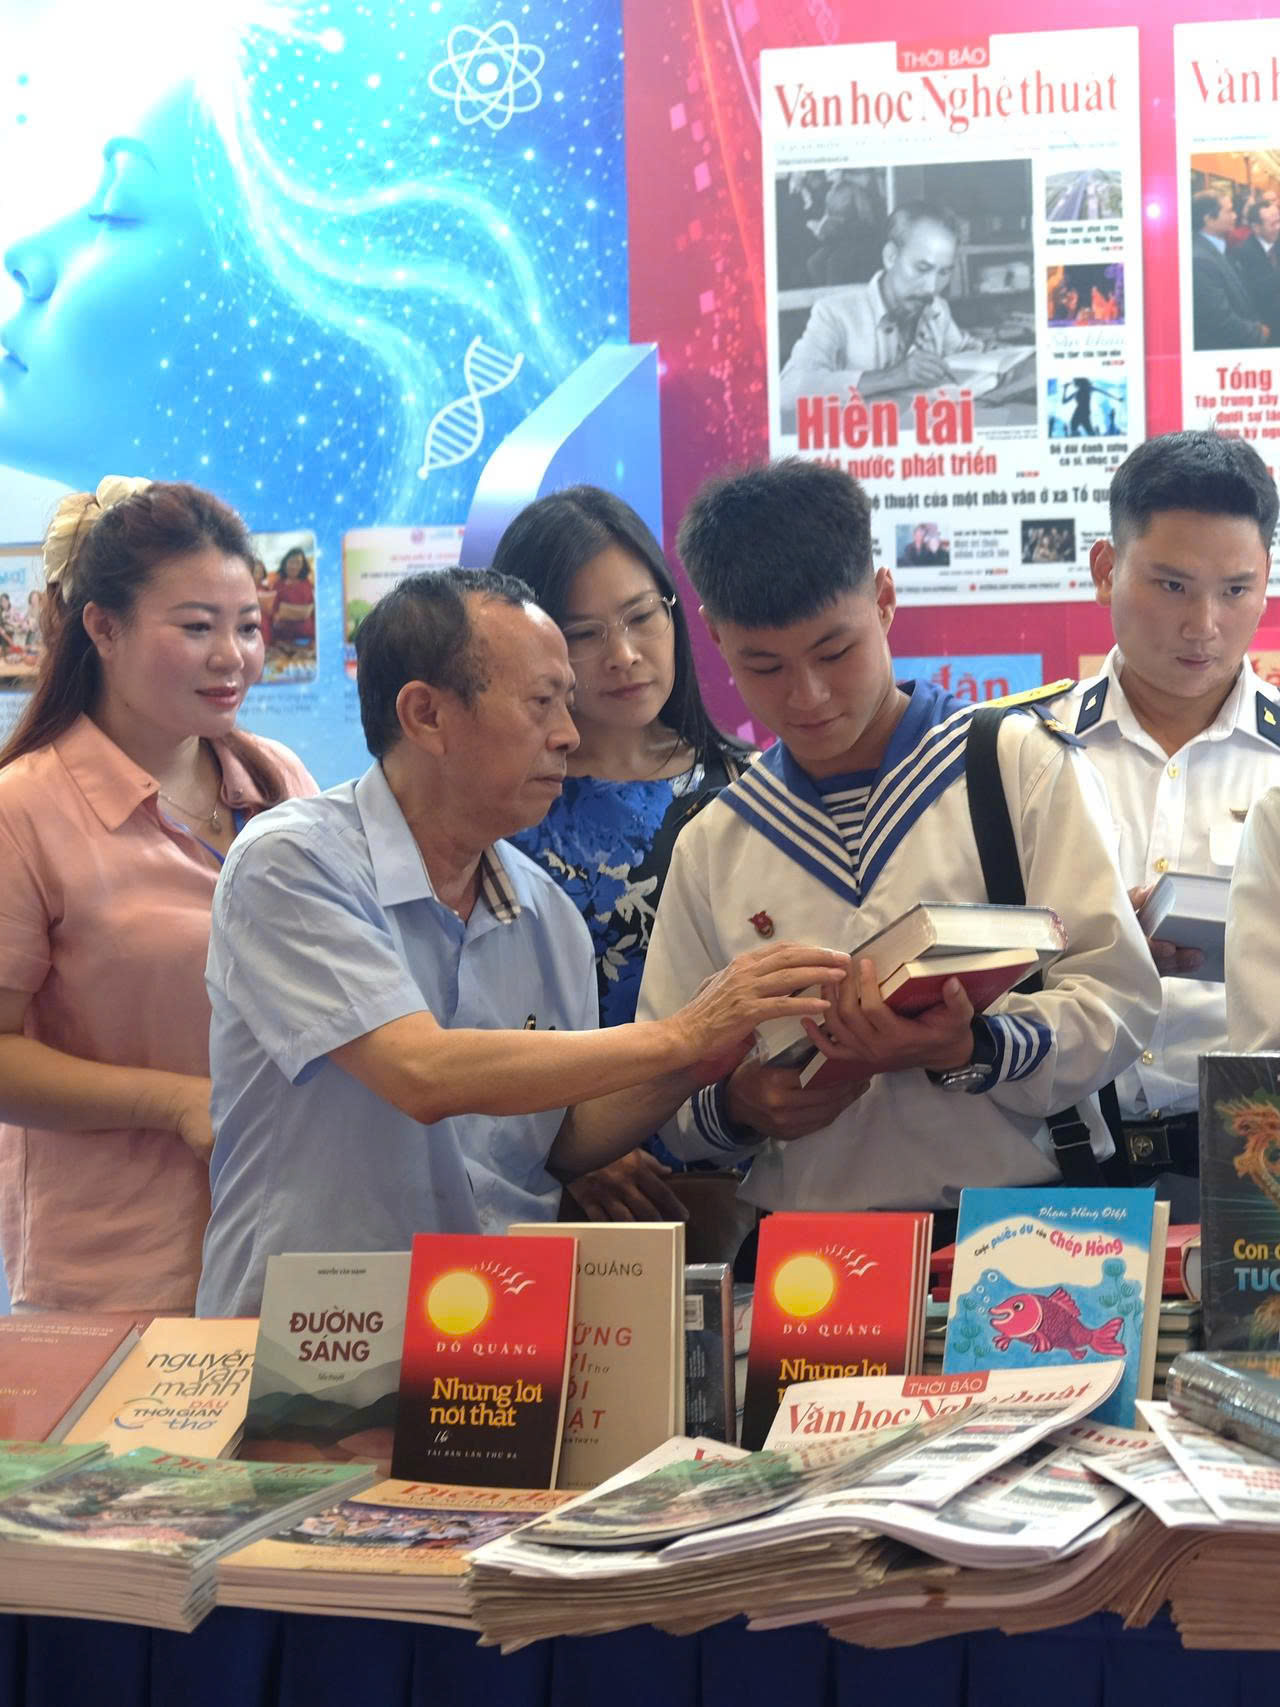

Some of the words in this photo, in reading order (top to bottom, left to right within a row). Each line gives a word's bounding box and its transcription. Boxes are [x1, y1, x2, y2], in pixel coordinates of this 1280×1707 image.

[949, 46, 986, 66] BÁO
[850, 80, 912, 128] học
[1217, 363, 1272, 391] Tổng
[796, 385, 899, 450] Hiền
[914, 389, 974, 446] tài
[901, 452, 944, 480] phát
[950, 446, 997, 476] triển
[1050, 1230, 1083, 1258] Chép
[1085, 1235, 1124, 1257] Hồng
[1233, 1238, 1269, 1261] Con
[289, 1305, 384, 1333] ĐƯỜNG
[298, 1334, 371, 1361] SÁNG
[909, 1382, 946, 1395] THỜI
[950, 1378, 983, 1393] BÁO
[789, 1401, 847, 1434] Văn
[850, 1401, 911, 1430] học
